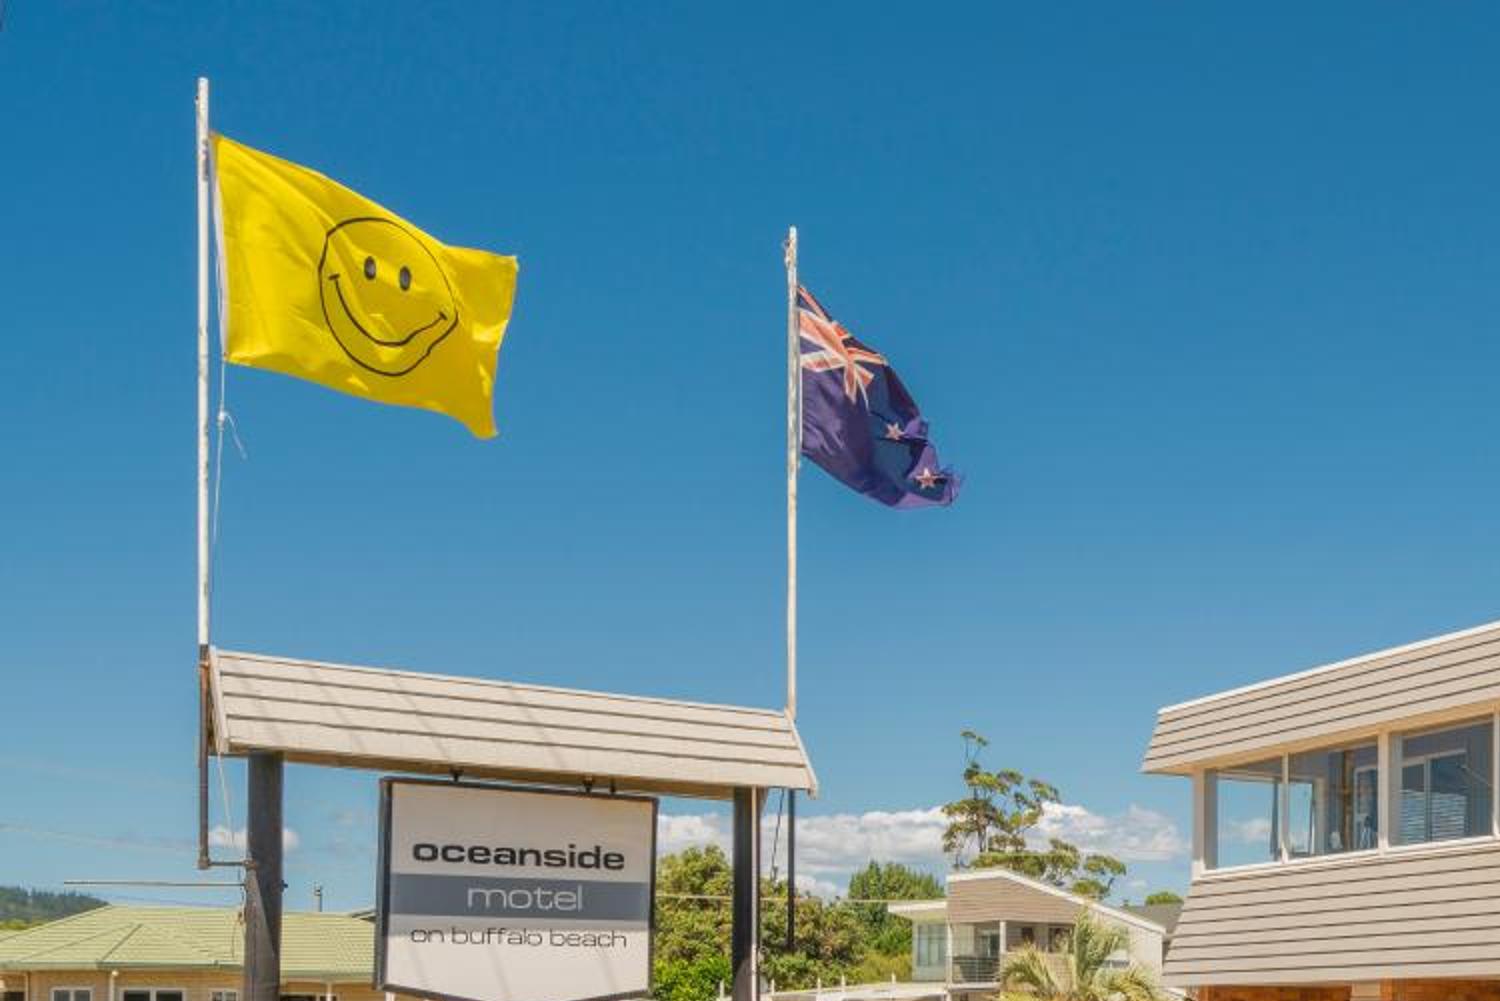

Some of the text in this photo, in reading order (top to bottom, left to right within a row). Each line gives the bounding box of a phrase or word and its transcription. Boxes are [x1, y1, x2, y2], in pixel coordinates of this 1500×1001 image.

[412, 843, 625, 870] oceanside
[467, 885, 583, 911] motel
[411, 927, 627, 948] on buffalo beach
